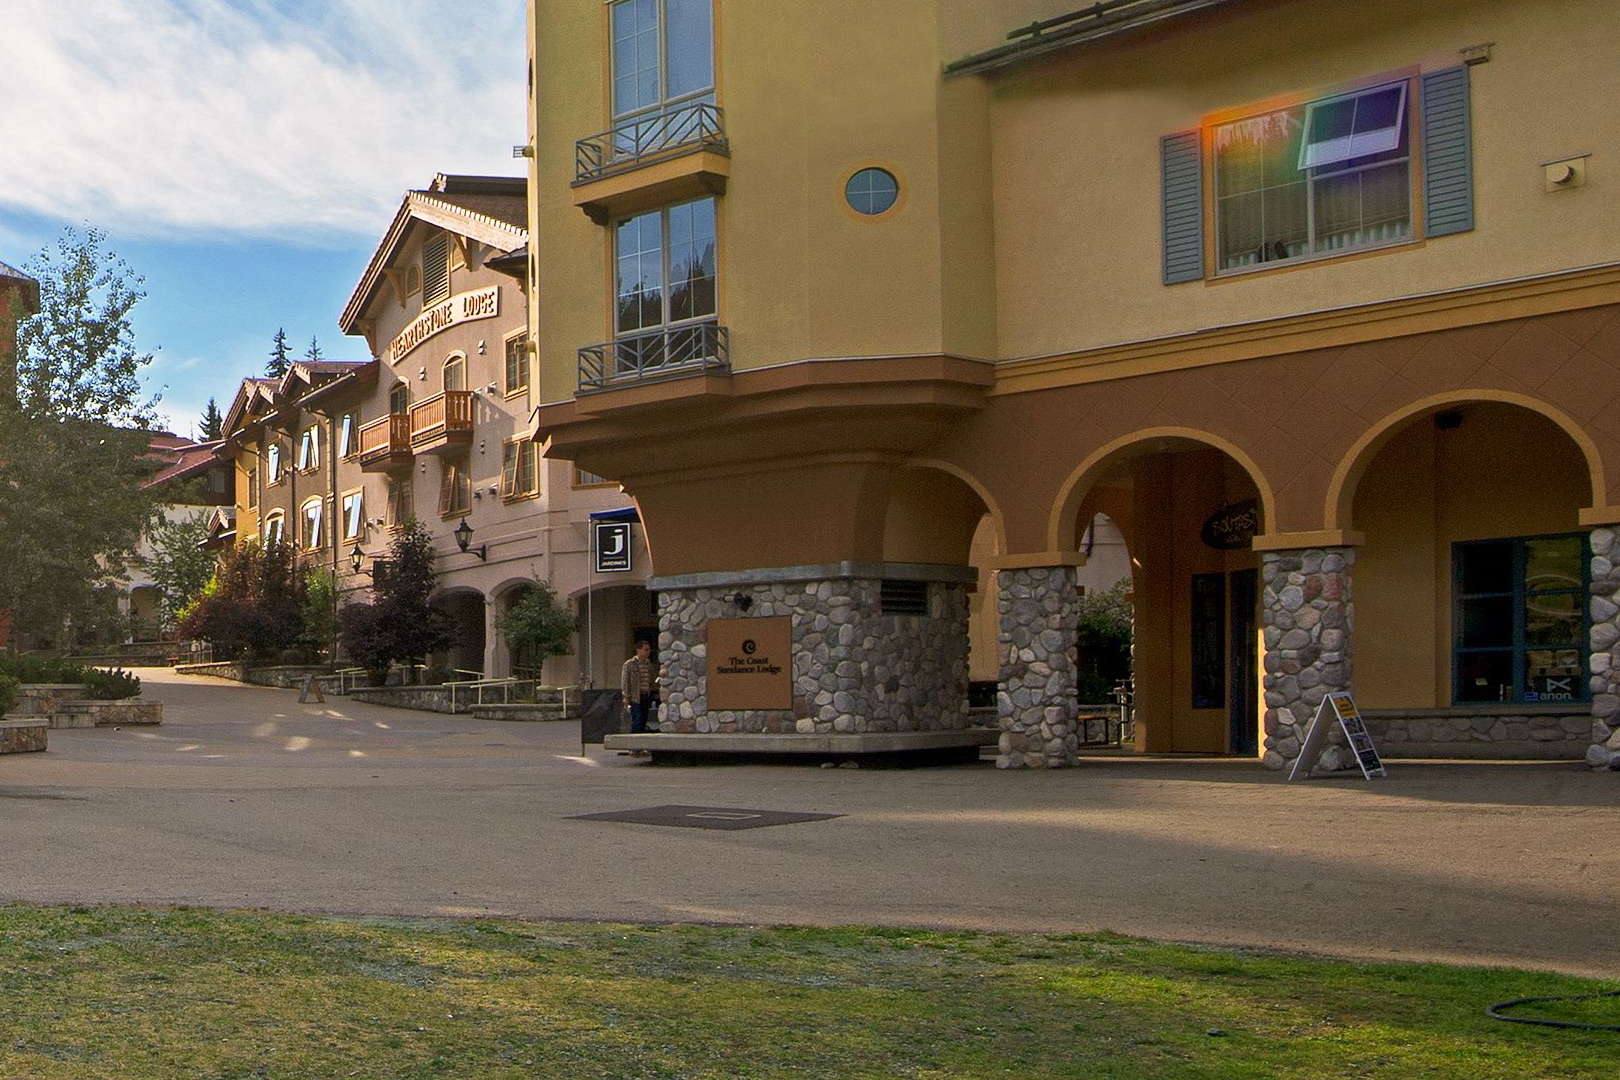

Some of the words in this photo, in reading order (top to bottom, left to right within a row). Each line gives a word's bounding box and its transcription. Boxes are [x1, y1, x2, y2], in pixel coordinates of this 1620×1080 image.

[390, 302, 453, 360] HEARTHSTONE
[463, 291, 496, 318] LODGE
[729, 656, 745, 665] The
[746, 656, 768, 665] Coast
[716, 665, 755, 674] Sundance
[757, 664, 782, 675] Lodge
